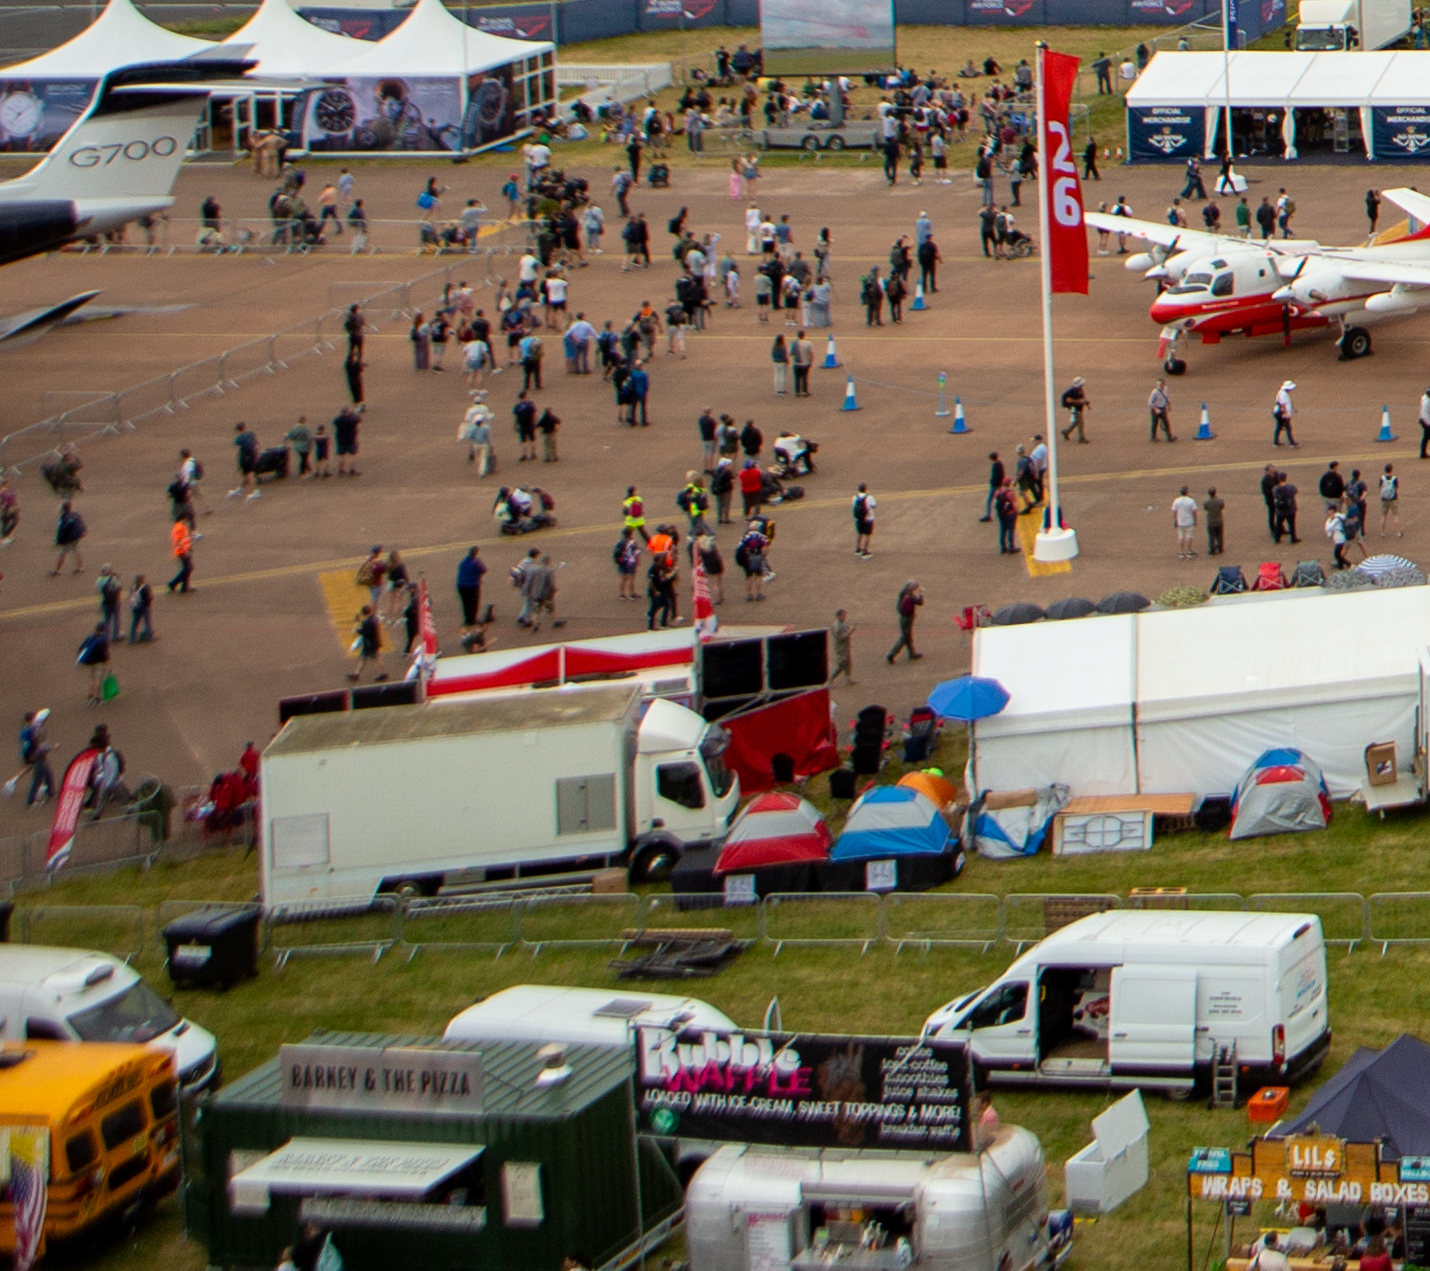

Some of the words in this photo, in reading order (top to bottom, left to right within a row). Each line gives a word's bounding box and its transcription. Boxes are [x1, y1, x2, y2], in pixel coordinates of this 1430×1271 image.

[1142, 115, 1192, 125] MERCHANDISE
[1152, 107, 1183, 115] OFFICIAL
[1395, 107, 1426, 115] OFFICIAL
[69, 135, 179, 168] G700
[640, 1026, 802, 1079] Bubble
[291, 1065, 358, 1090] BARNEY
[364, 1068, 377, 1090] &
[382, 1067, 415, 1093] THE
[420, 1070, 472, 1096] PIZZA
[664, 1061, 814, 1096] WAFFLE
[645, 1088, 691, 1105] LOADED
[694, 1091, 726, 1107] WITH
[727, 1093, 797, 1115] ICE-CREAM,
[799, 1100, 840, 1115] SWEET
[844, 1101, 907, 1118] TOPPINGS
[909, 1106, 918, 1117] &
[920, 1104, 963, 1120] MORE!
[1201, 1175, 1264, 1198] WRAPS
[1275, 1178, 1294, 1198] &
[1303, 1179, 1362, 1201] SALAD
[1369, 1182, 1430, 1204] BOXES
